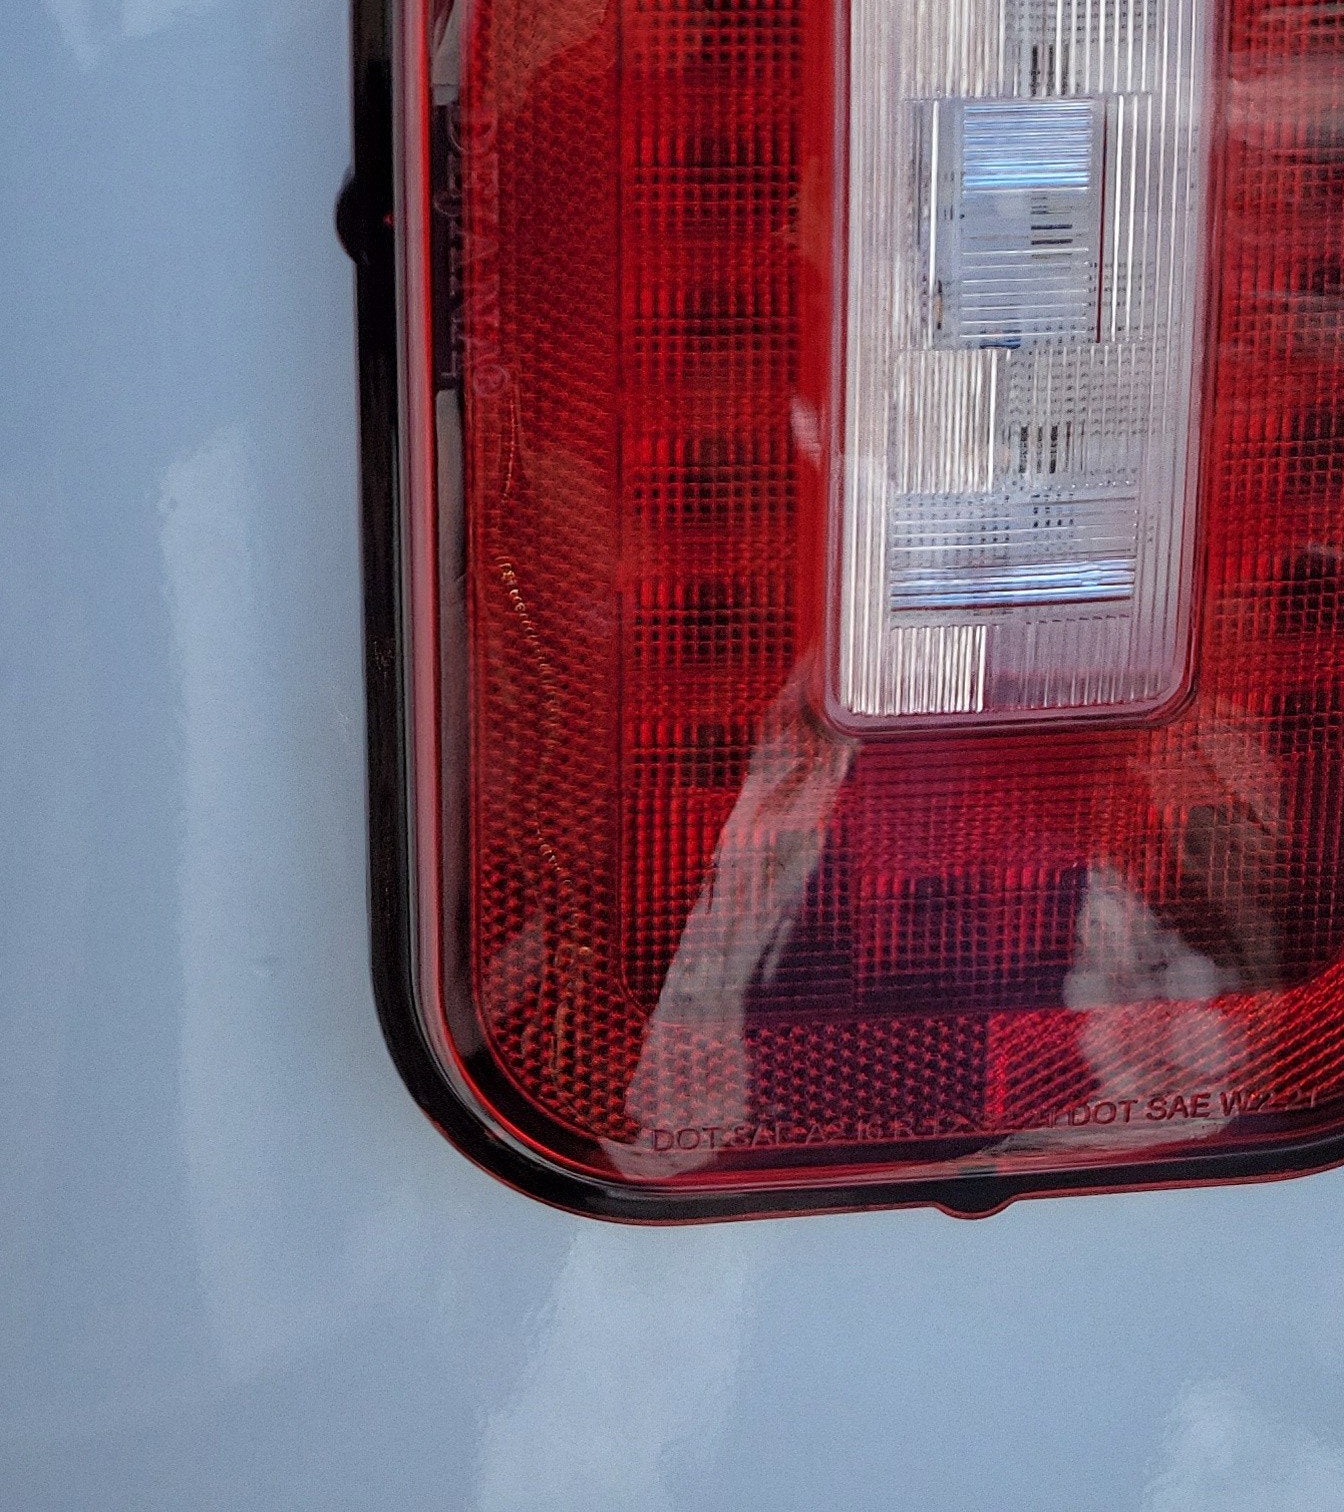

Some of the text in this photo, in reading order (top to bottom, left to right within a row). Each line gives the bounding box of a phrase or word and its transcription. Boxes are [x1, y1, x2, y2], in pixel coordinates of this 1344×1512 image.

[652, 1126, 721, 1152] DOT
[729, 1122, 795, 1148] SAE
[1067, 1098, 1137, 1127] DOT
[1145, 1092, 1211, 1121] SAE
